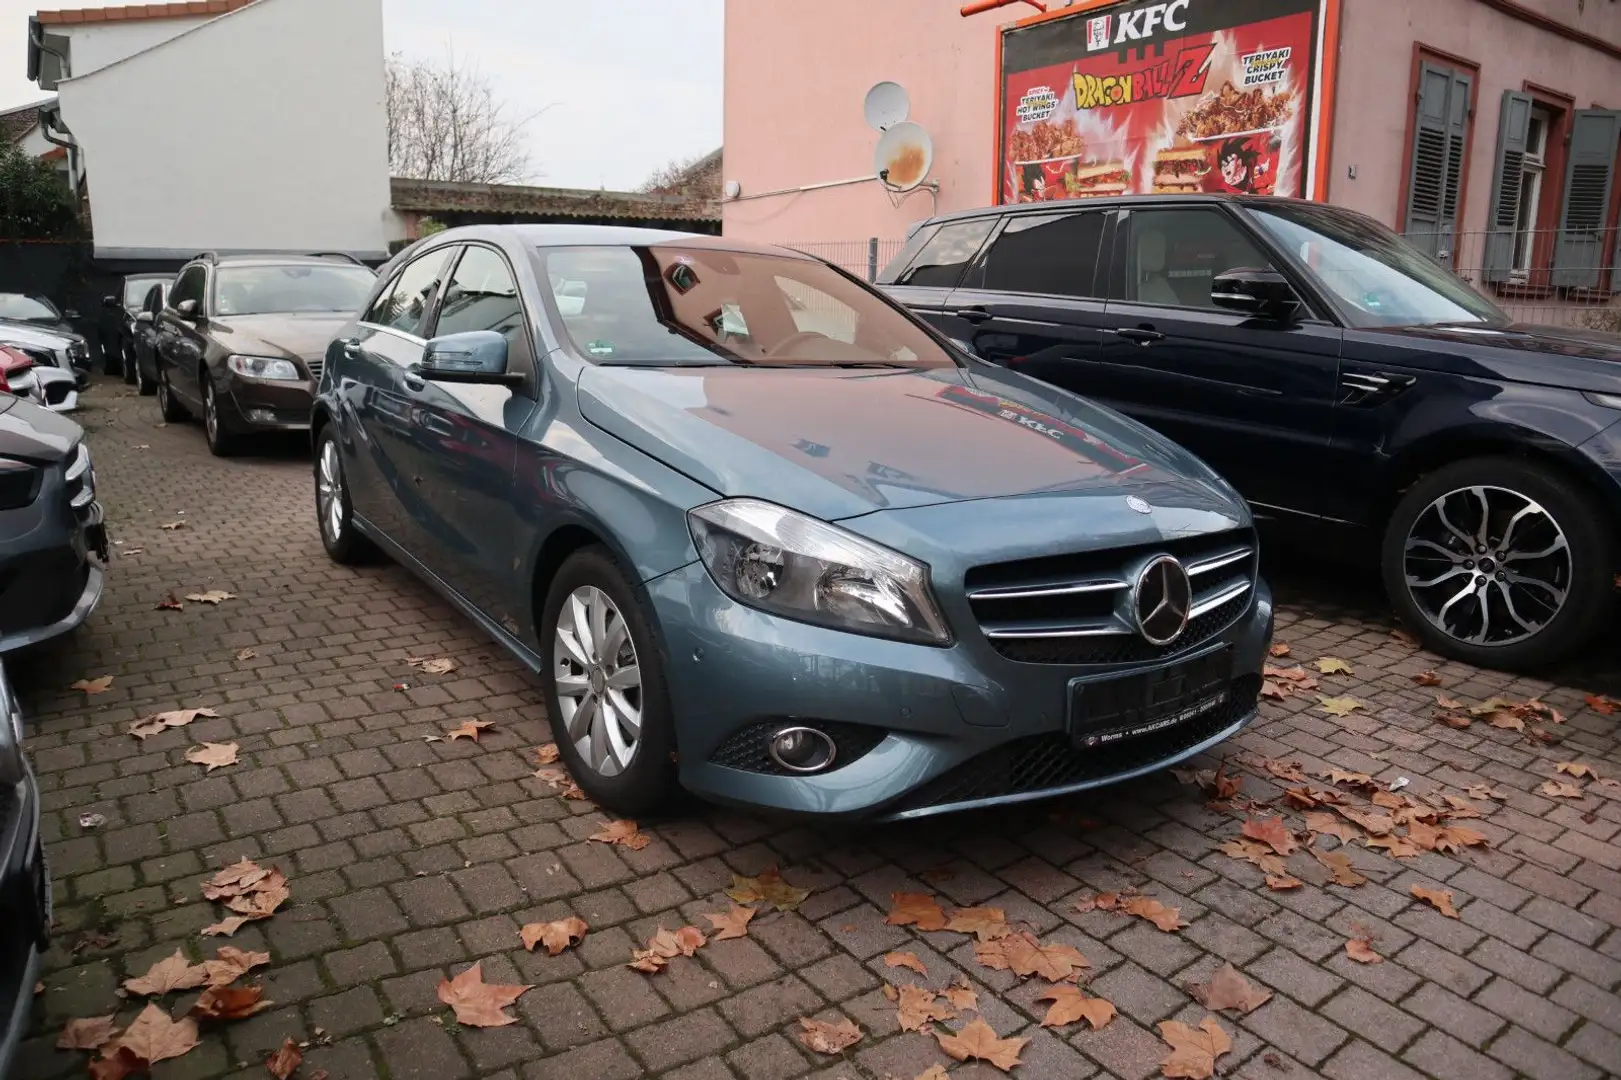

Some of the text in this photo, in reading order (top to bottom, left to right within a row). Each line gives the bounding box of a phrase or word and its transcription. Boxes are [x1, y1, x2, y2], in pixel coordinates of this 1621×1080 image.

[1114, 0, 1189, 44] KFC
[1243, 49, 1289, 65] TERIYAKI
[1167, 42, 1218, 100] Z
[1246, 60, 1283, 74] CRISPY
[1244, 70, 1284, 85] BUCKET
[1021, 93, 1054, 104] TERIYAKI
[1017, 106, 1031, 114] HOT
[1022, 111, 1050, 122] BUCKET
[1101, 732, 1123, 742] Worms
